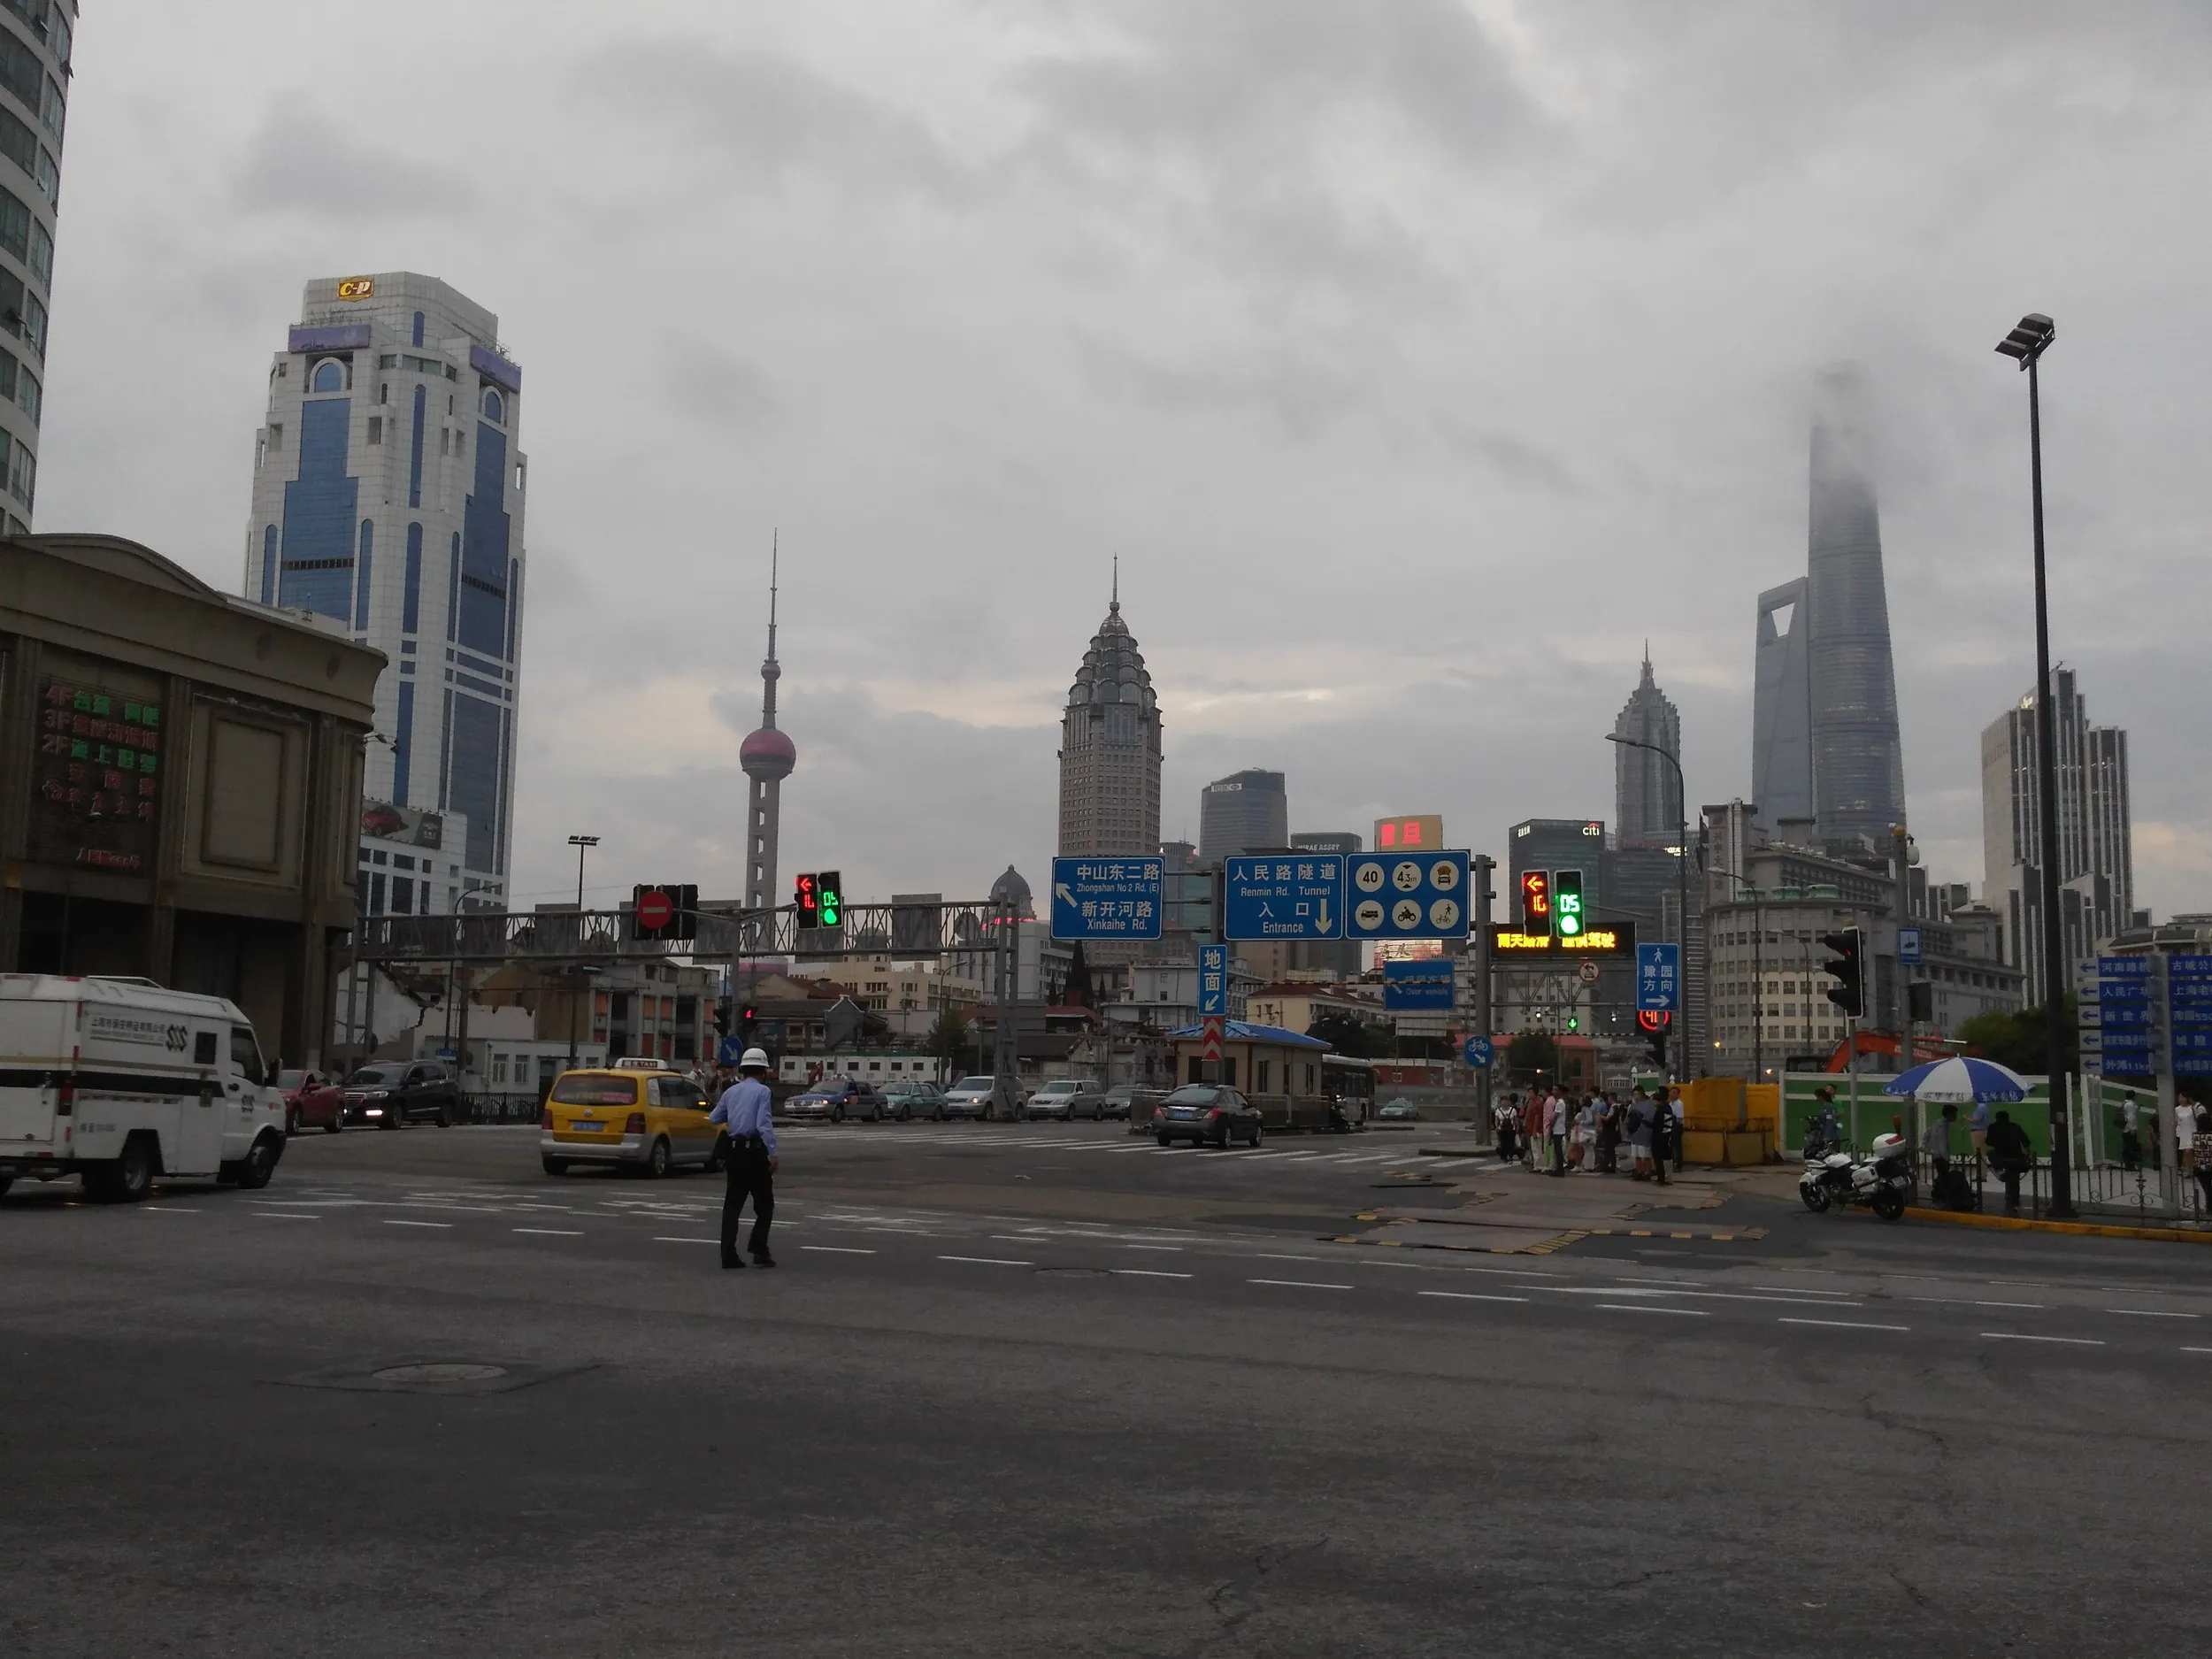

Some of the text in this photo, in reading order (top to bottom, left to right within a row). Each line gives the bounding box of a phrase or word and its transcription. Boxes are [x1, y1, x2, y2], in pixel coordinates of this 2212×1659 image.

[43, 709, 72, 730] 3F
[42, 733, 68, 755] 2F
[1582, 826, 1600, 836] citi
[1077, 864, 1160, 880] 中山东二路
[1233, 863, 1336, 881] 人民路隧道
[1363, 871, 1378, 883] 40
[1077, 883, 1159, 894] Zhongshan No 2 Rd. (E)
[1240, 886, 1330, 896] Renmin Rd. Tunnel
[1081, 901, 1153, 918] 新开河路
[1258, 902, 1310, 918] 入口
[1560, 895, 1580, 912] 05
[1087, 918, 1148, 930] Xinkaihe Rd.
[1263, 922, 1303, 933] Entrance
[1203, 949, 1221, 992] 地面
[1643, 964, 1673, 978] 豫园
[2171, 960, 2212, 971] 古城公
[1643, 979, 1673, 992] 方向
[2174, 985, 2212, 995] 上海老
